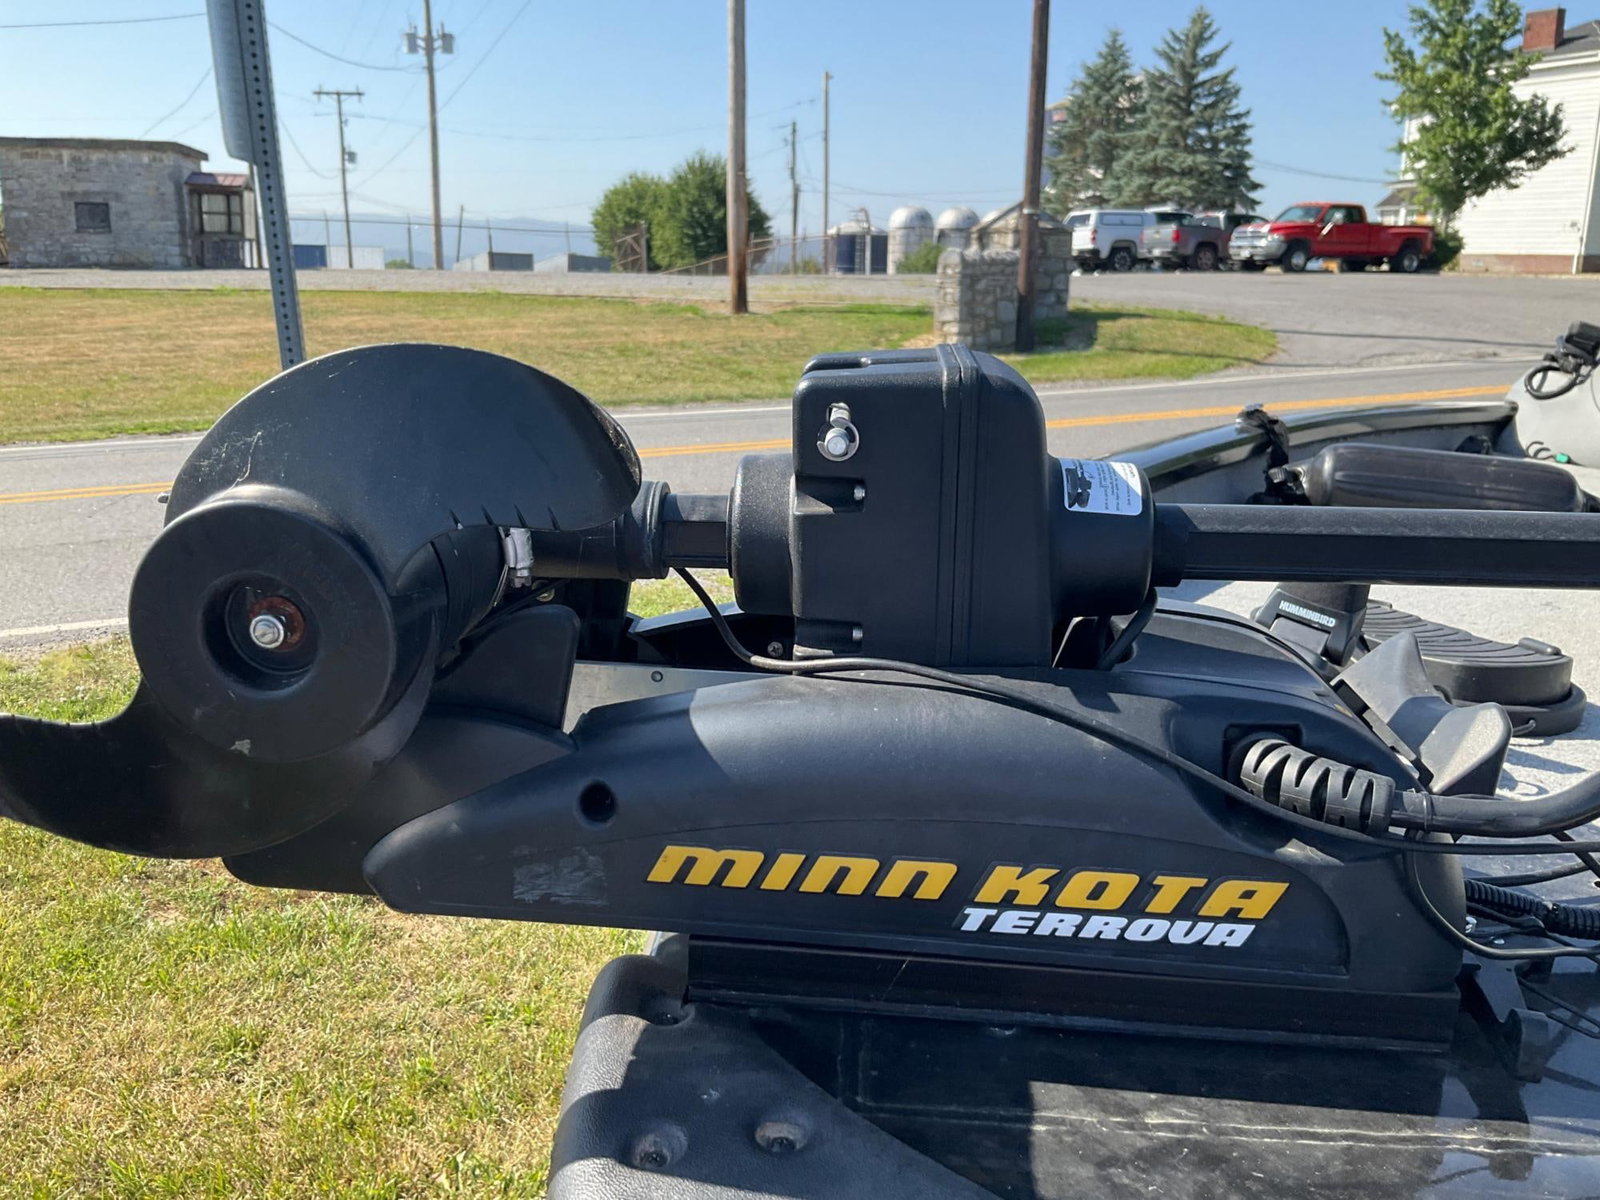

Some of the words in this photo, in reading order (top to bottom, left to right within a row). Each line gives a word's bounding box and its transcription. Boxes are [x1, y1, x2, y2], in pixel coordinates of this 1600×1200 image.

[1279, 600, 1336, 628] HUMMINBIRD
[973, 865, 1289, 919] KOTA
[960, 907, 1256, 948] TERROVA
